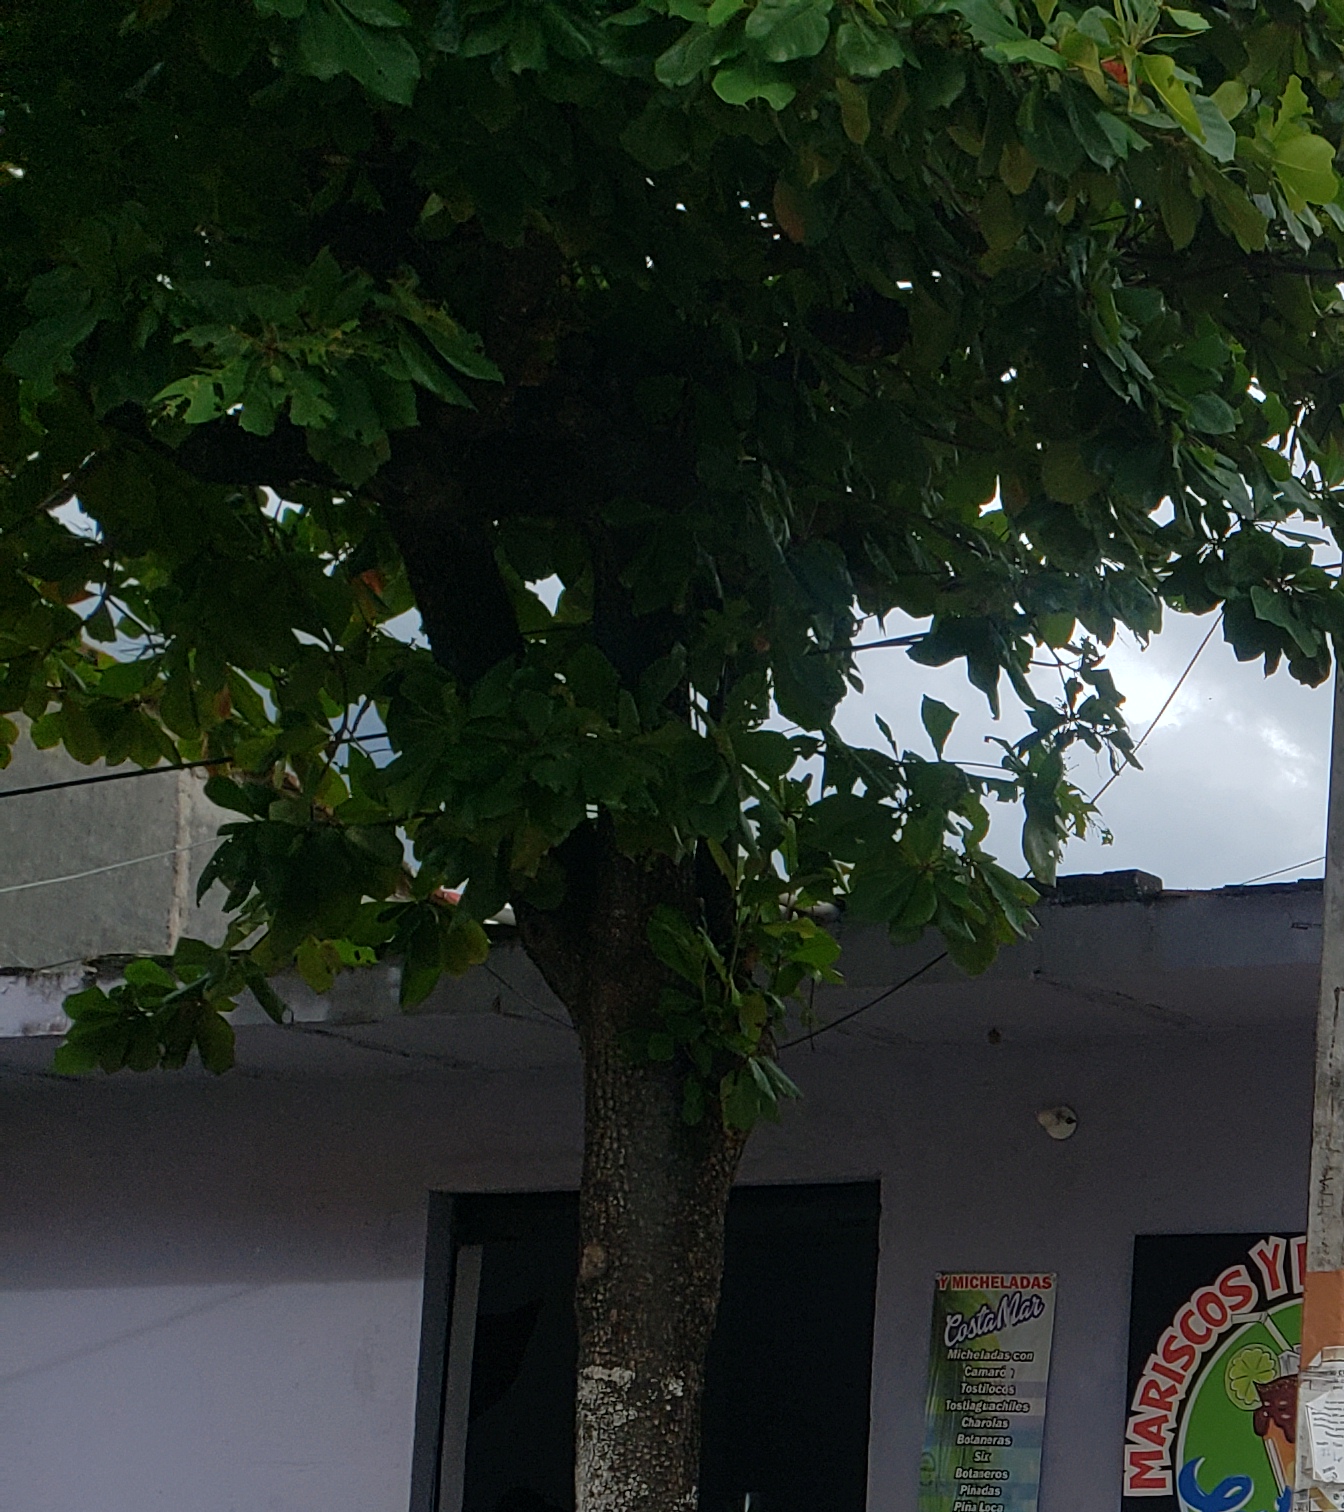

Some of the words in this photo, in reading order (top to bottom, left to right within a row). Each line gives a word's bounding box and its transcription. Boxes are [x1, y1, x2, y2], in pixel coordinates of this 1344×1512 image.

[951, 1275, 1053, 1290] MICHELADAS
[947, 1349, 1011, 1360] Micheladas
[1012, 1351, 1034, 1361] con
[964, 1365, 1015, 1378] Camaró
[1127, 1267, 1255, 1492] MARISCOS
[1252, 1240, 1285, 1296] Y
[961, 1382, 1016, 1395] Tostilocos
[945, 1400, 1030, 1413] Tostiaguachiles
[961, 1417, 1009, 1428] Charolas
[956, 1433, 1012, 1445] Botaneras
[974, 1450, 992, 1462] Six
[955, 1467, 1009, 1479] Botaneros
[953, 1501, 977, 1512] Piña
[978, 1501, 1004, 1512] Loca
